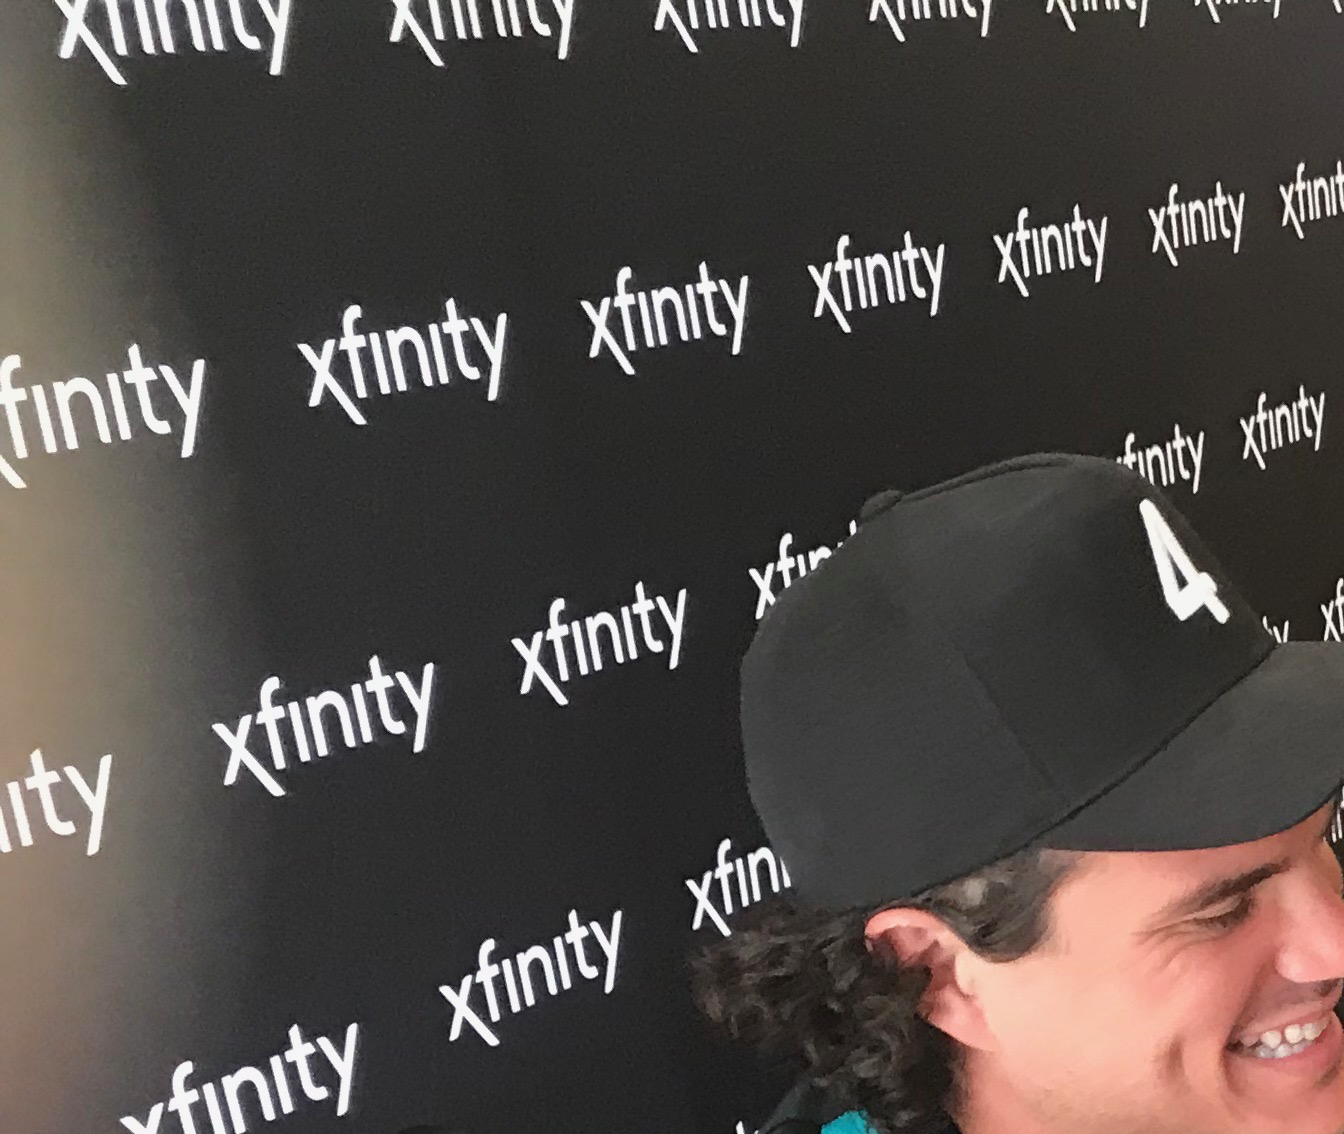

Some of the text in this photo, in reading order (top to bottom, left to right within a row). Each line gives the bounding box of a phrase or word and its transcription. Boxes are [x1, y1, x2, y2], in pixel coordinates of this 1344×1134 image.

[808, 231, 944, 333] xfinity
[994, 204, 1108, 297] xfinity
[1147, 181, 1245, 266] xfinity
[297, 298, 506, 425] xfinity
[580, 262, 748, 375] xfinity
[0, 344, 205, 488] finity
[1117, 424, 1205, 494] finity
[1240, 385, 1324, 470] xfinity
[1139, 498, 1230, 624] 4
[511, 581, 687, 706] xfinity
[212, 656, 435, 797] xfinity
[439, 910, 622, 1047] xfinity
